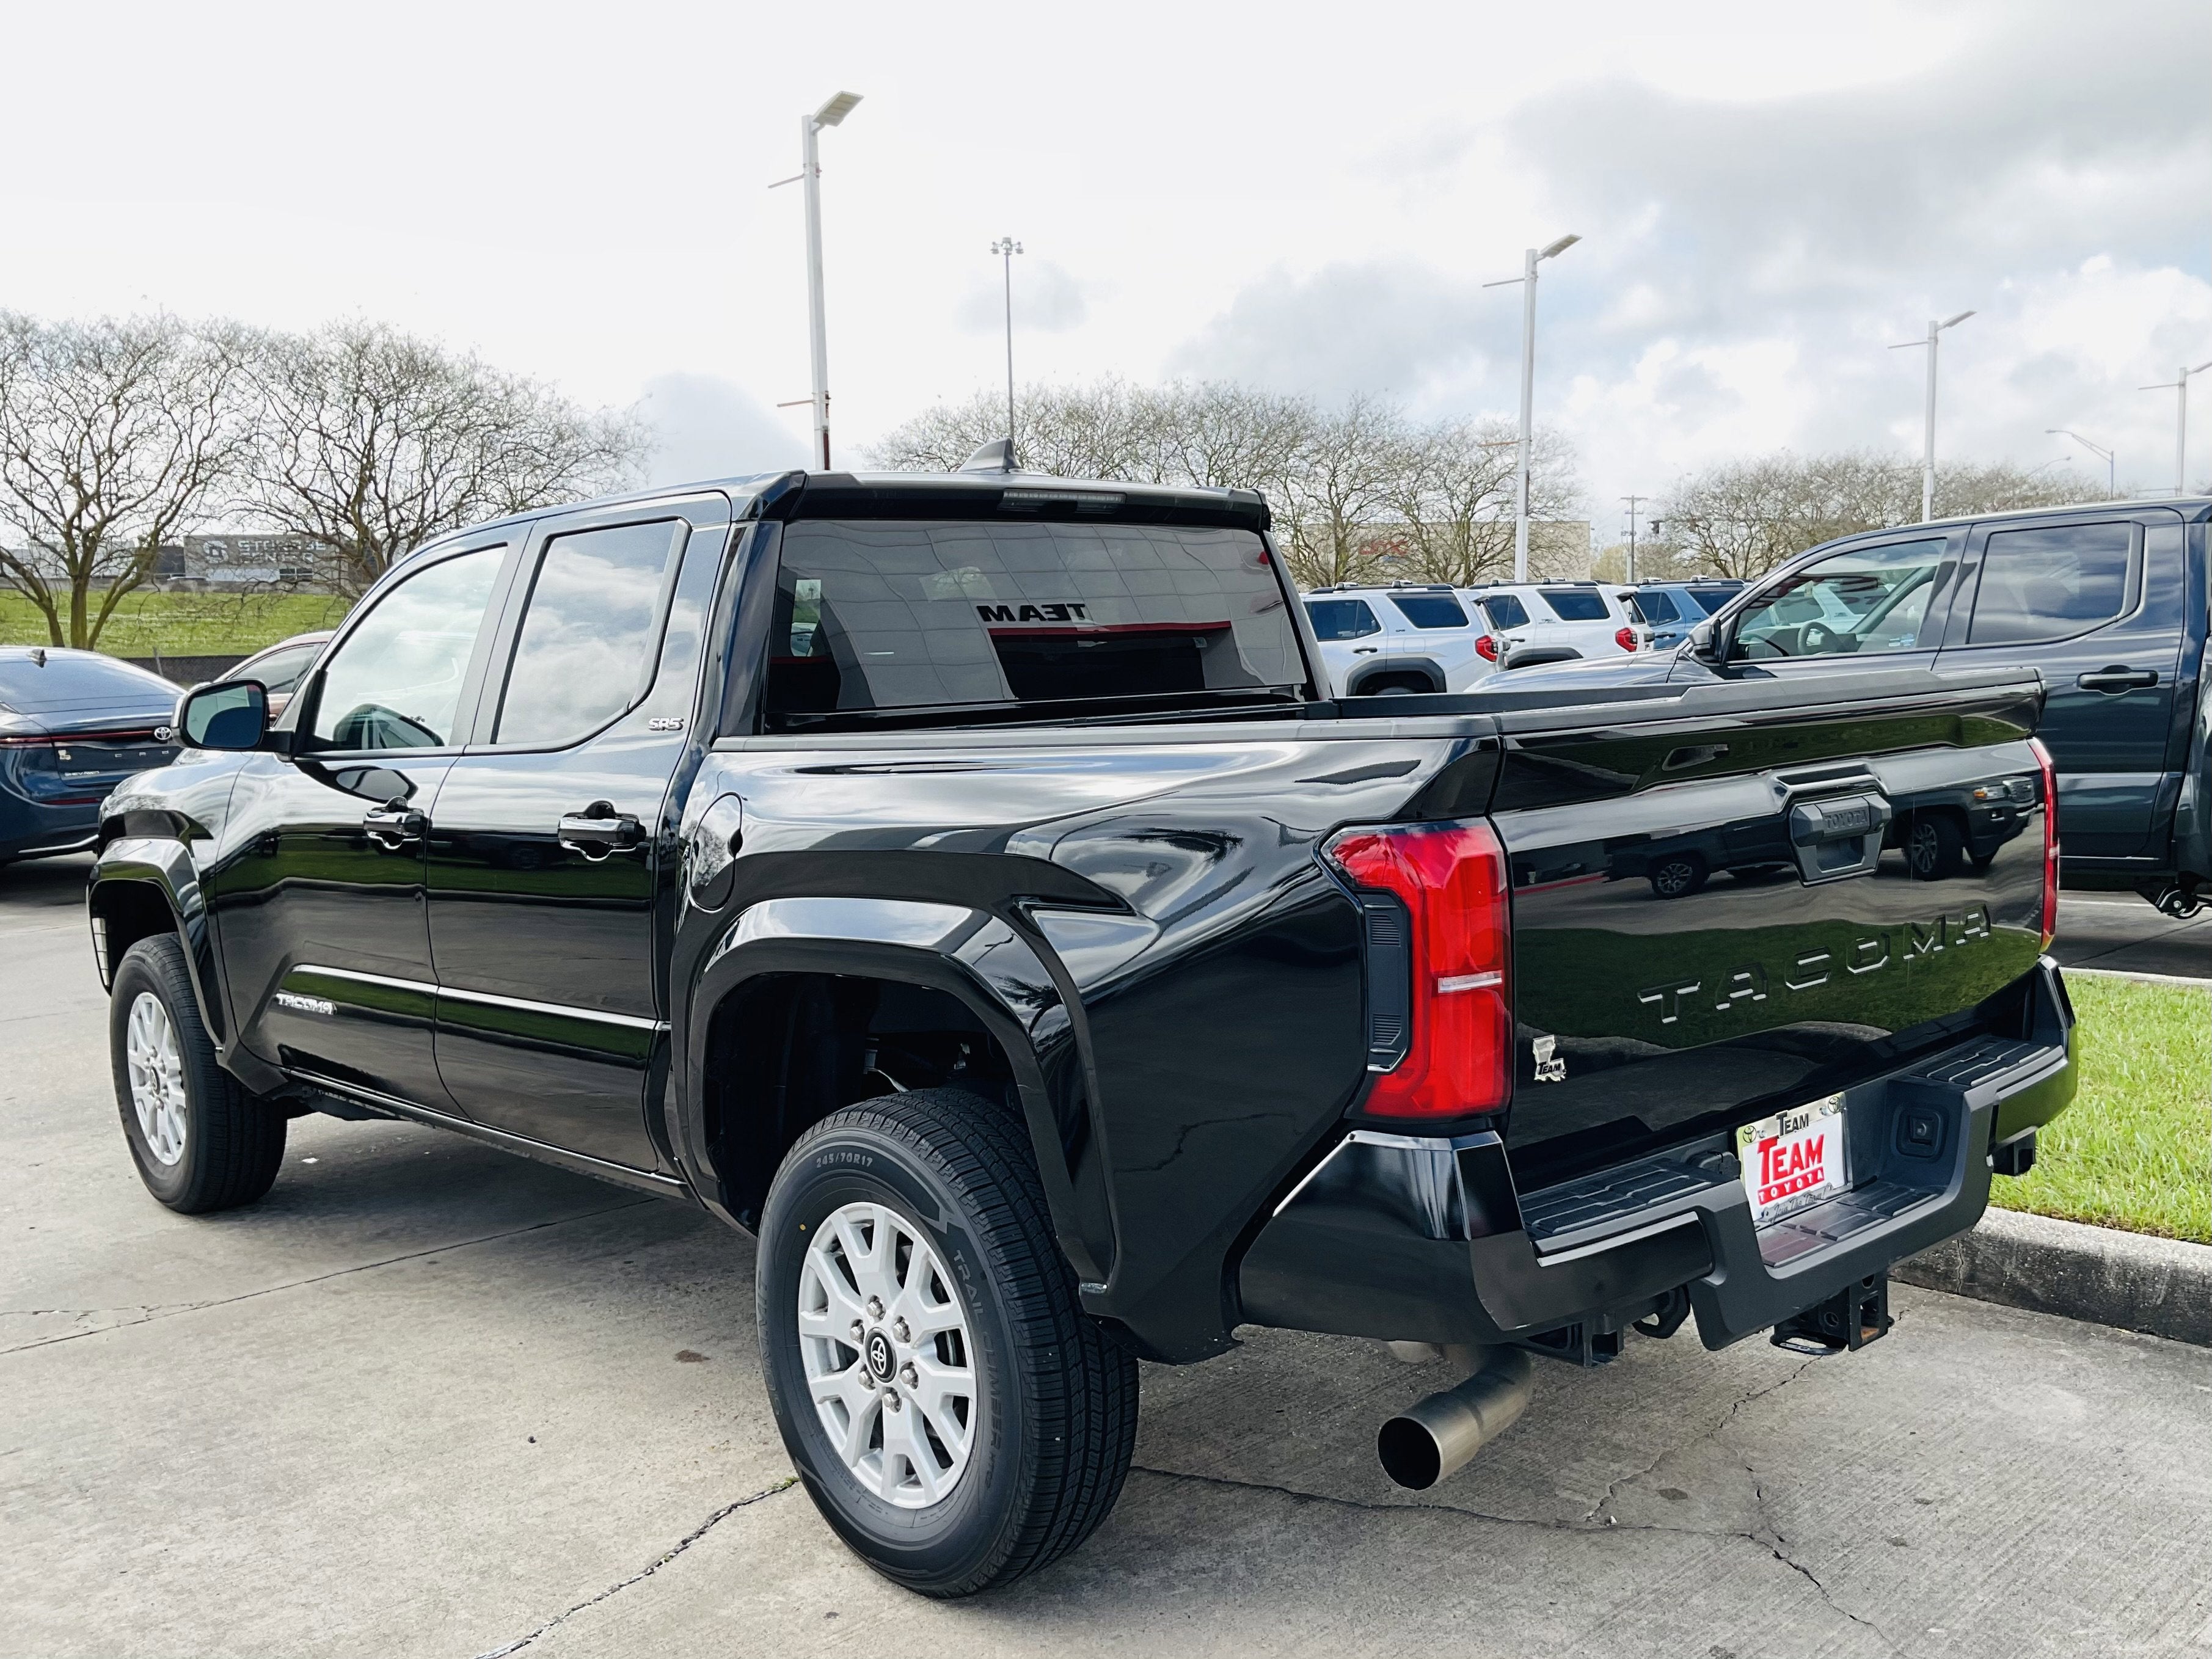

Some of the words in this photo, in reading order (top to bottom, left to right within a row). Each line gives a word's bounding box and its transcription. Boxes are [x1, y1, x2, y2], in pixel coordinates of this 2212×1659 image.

[648, 717, 684, 731] SR5
[1824, 809, 1868, 830] TOYOTA
[1638, 903, 1991, 1023] TACOMA
[276, 993, 337, 1015] TACOMA
[1538, 1061, 1561, 1075] TEAM
[1776, 1111, 1809, 1137] TEAM
[816, 1152, 873, 1169] 245/70R17
[1758, 1133, 1825, 1186] TEAM
[1759, 1169, 1824, 1203] TOYOTA
[953, 1249, 985, 1321] TRAIL
[982, 1330, 1002, 1451] CLIMBER
